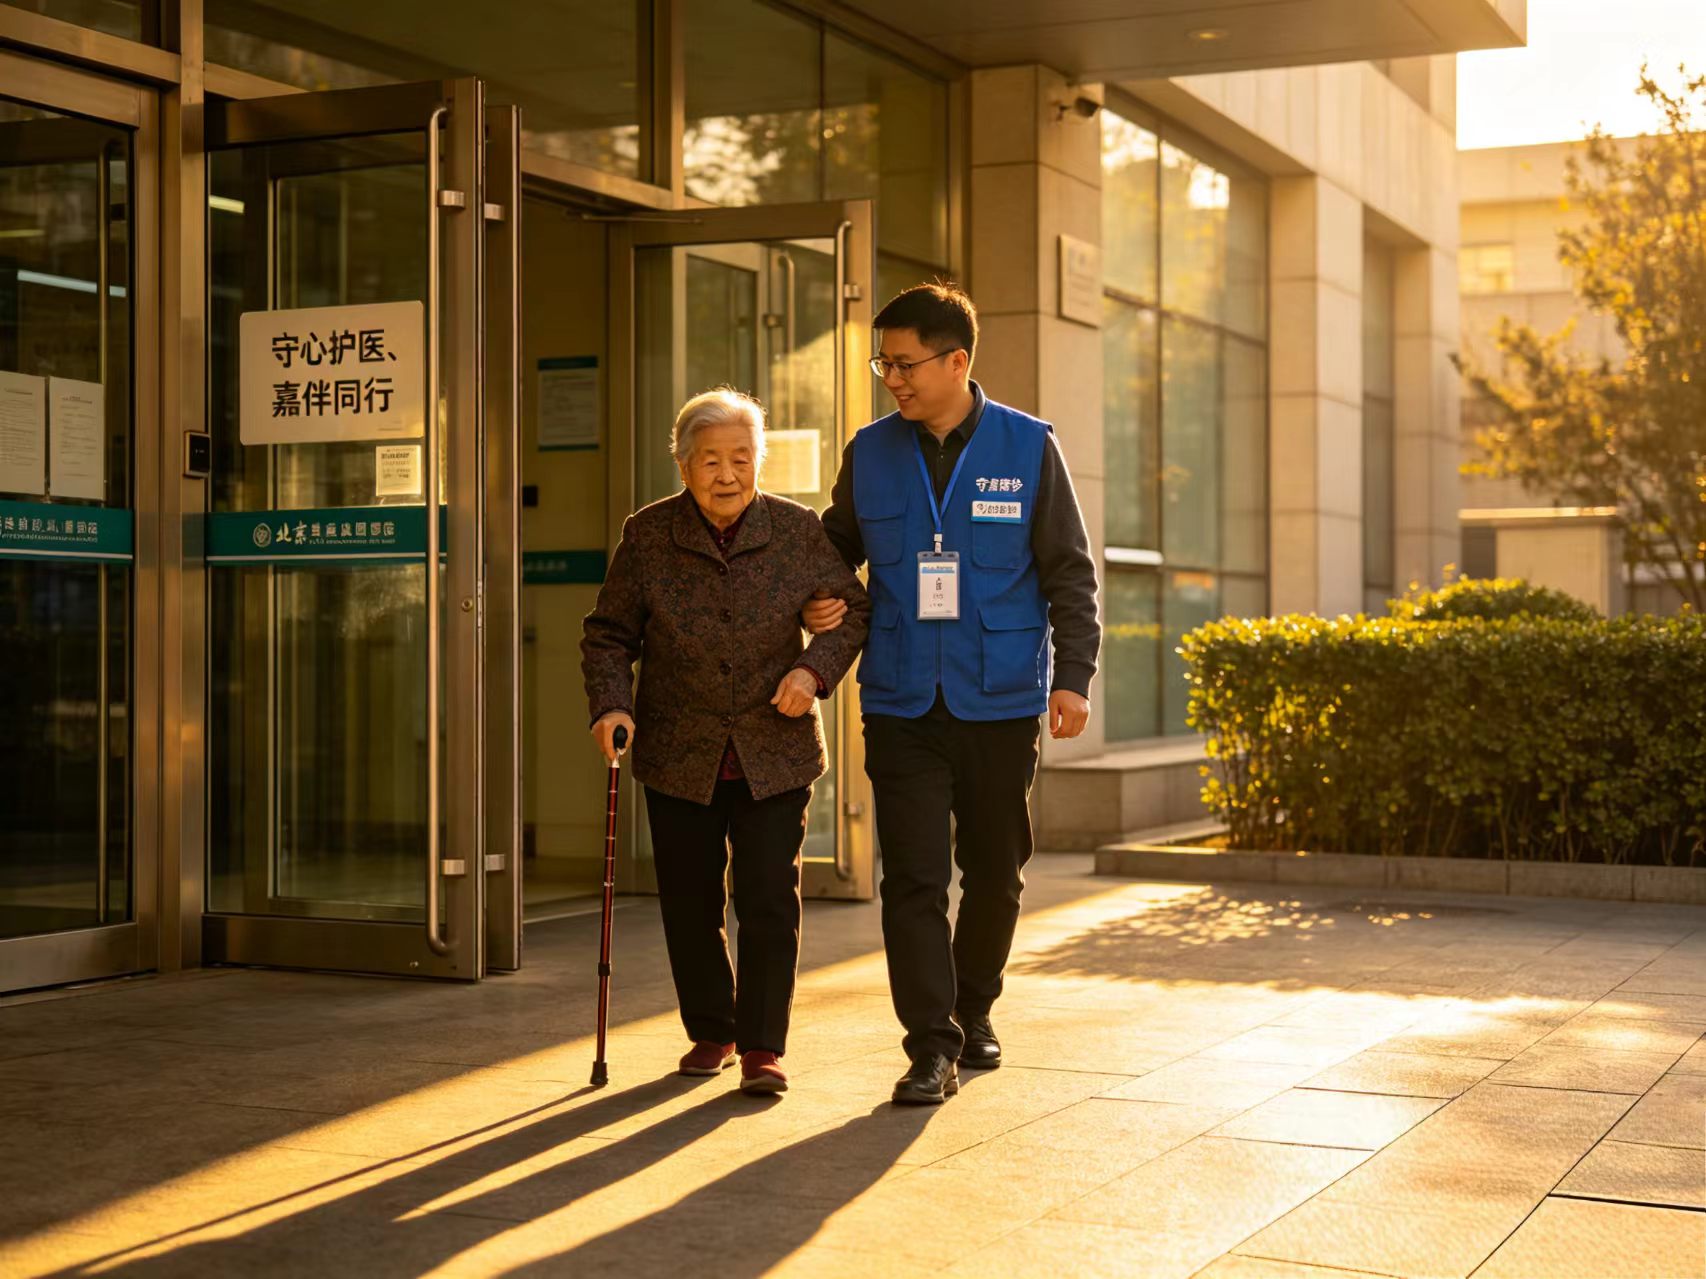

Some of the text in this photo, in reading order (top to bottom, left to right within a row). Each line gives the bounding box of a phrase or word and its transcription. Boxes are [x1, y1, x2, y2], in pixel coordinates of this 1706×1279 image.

[271, 329, 398, 368] 守心护医、
[271, 377, 394, 418] 嘉伴同行
